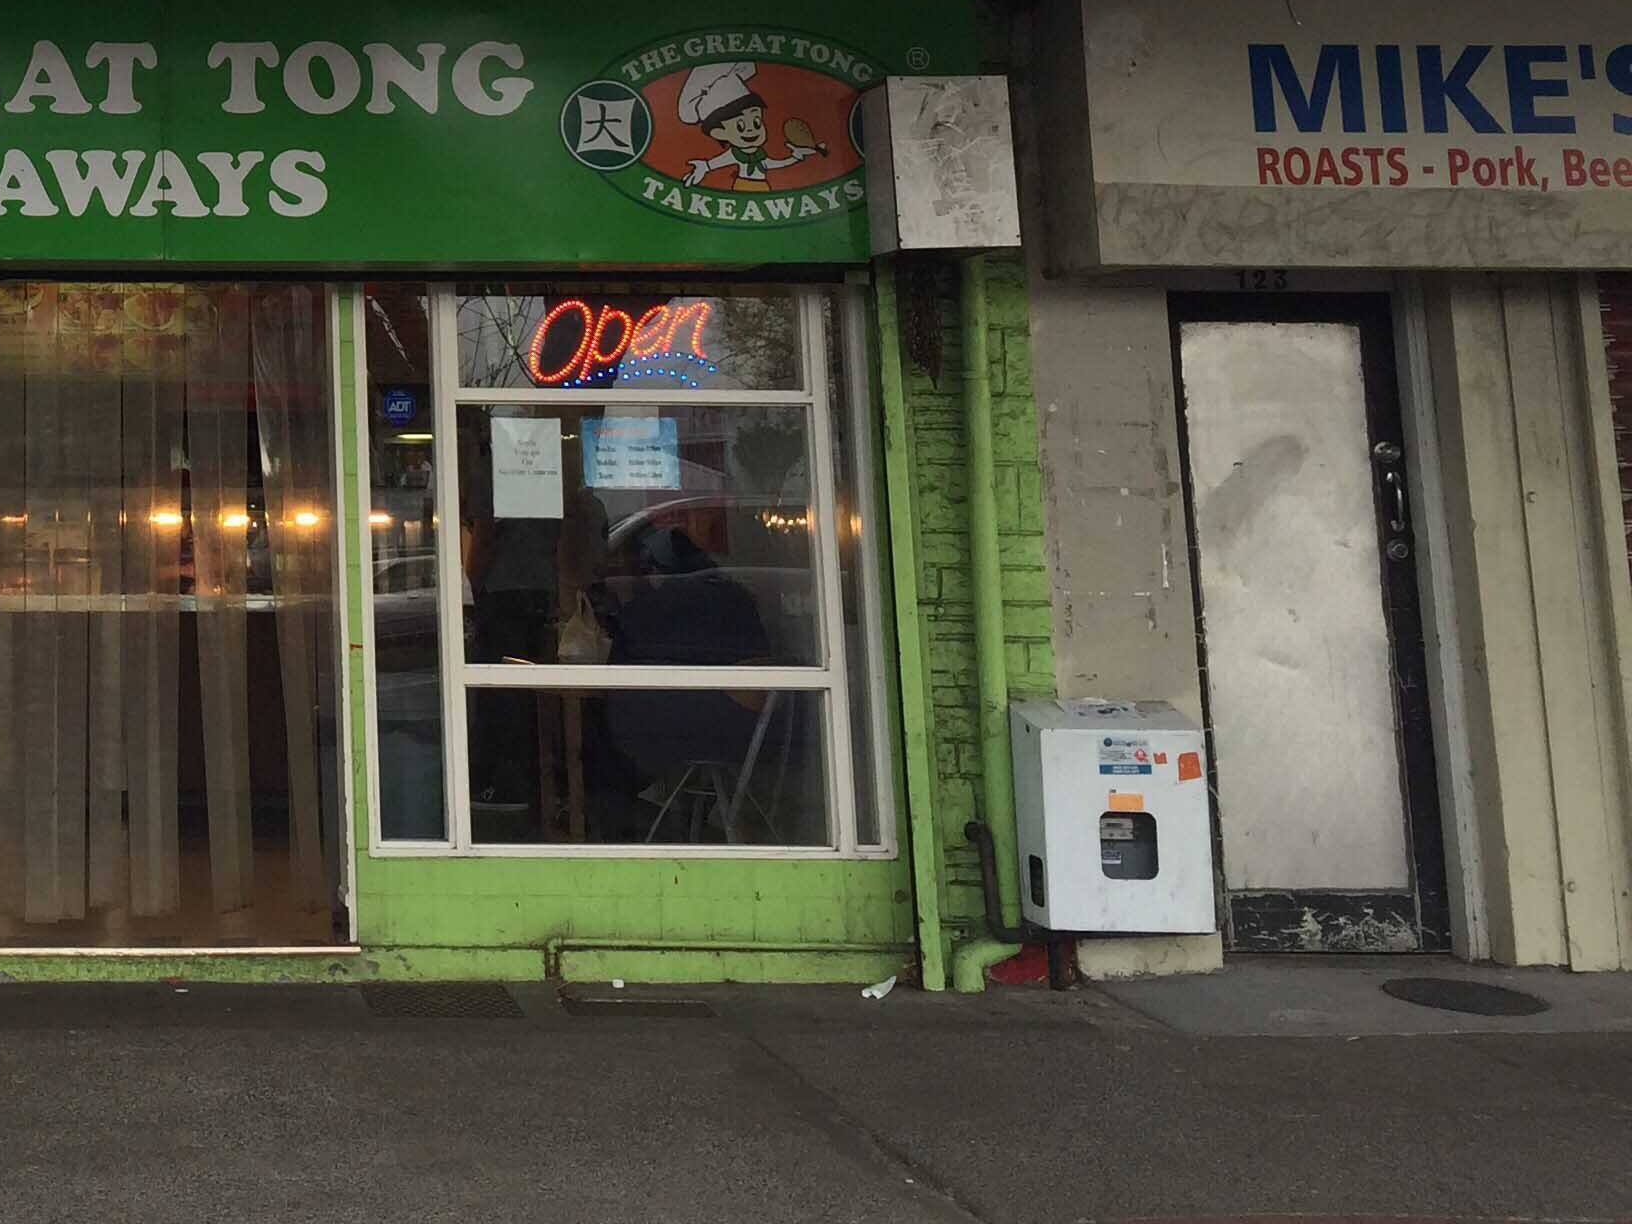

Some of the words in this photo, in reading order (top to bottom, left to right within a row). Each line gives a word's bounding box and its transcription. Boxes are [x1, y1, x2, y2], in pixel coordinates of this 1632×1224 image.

[207, 40, 535, 117] TONG
[621, 41, 681, 82] THE
[684, 33, 787, 57] GREAT
[790, 37, 873, 81] TONG
[583, 103, 631, 148] 大
[1257, 147, 1409, 187] ROASTS
[1447, 146, 1549, 192] Pork,
[643, 177, 865, 222] TAKEAWAYS
[529, 299, 714, 383] Open
[388, 401, 411, 413] ADT
